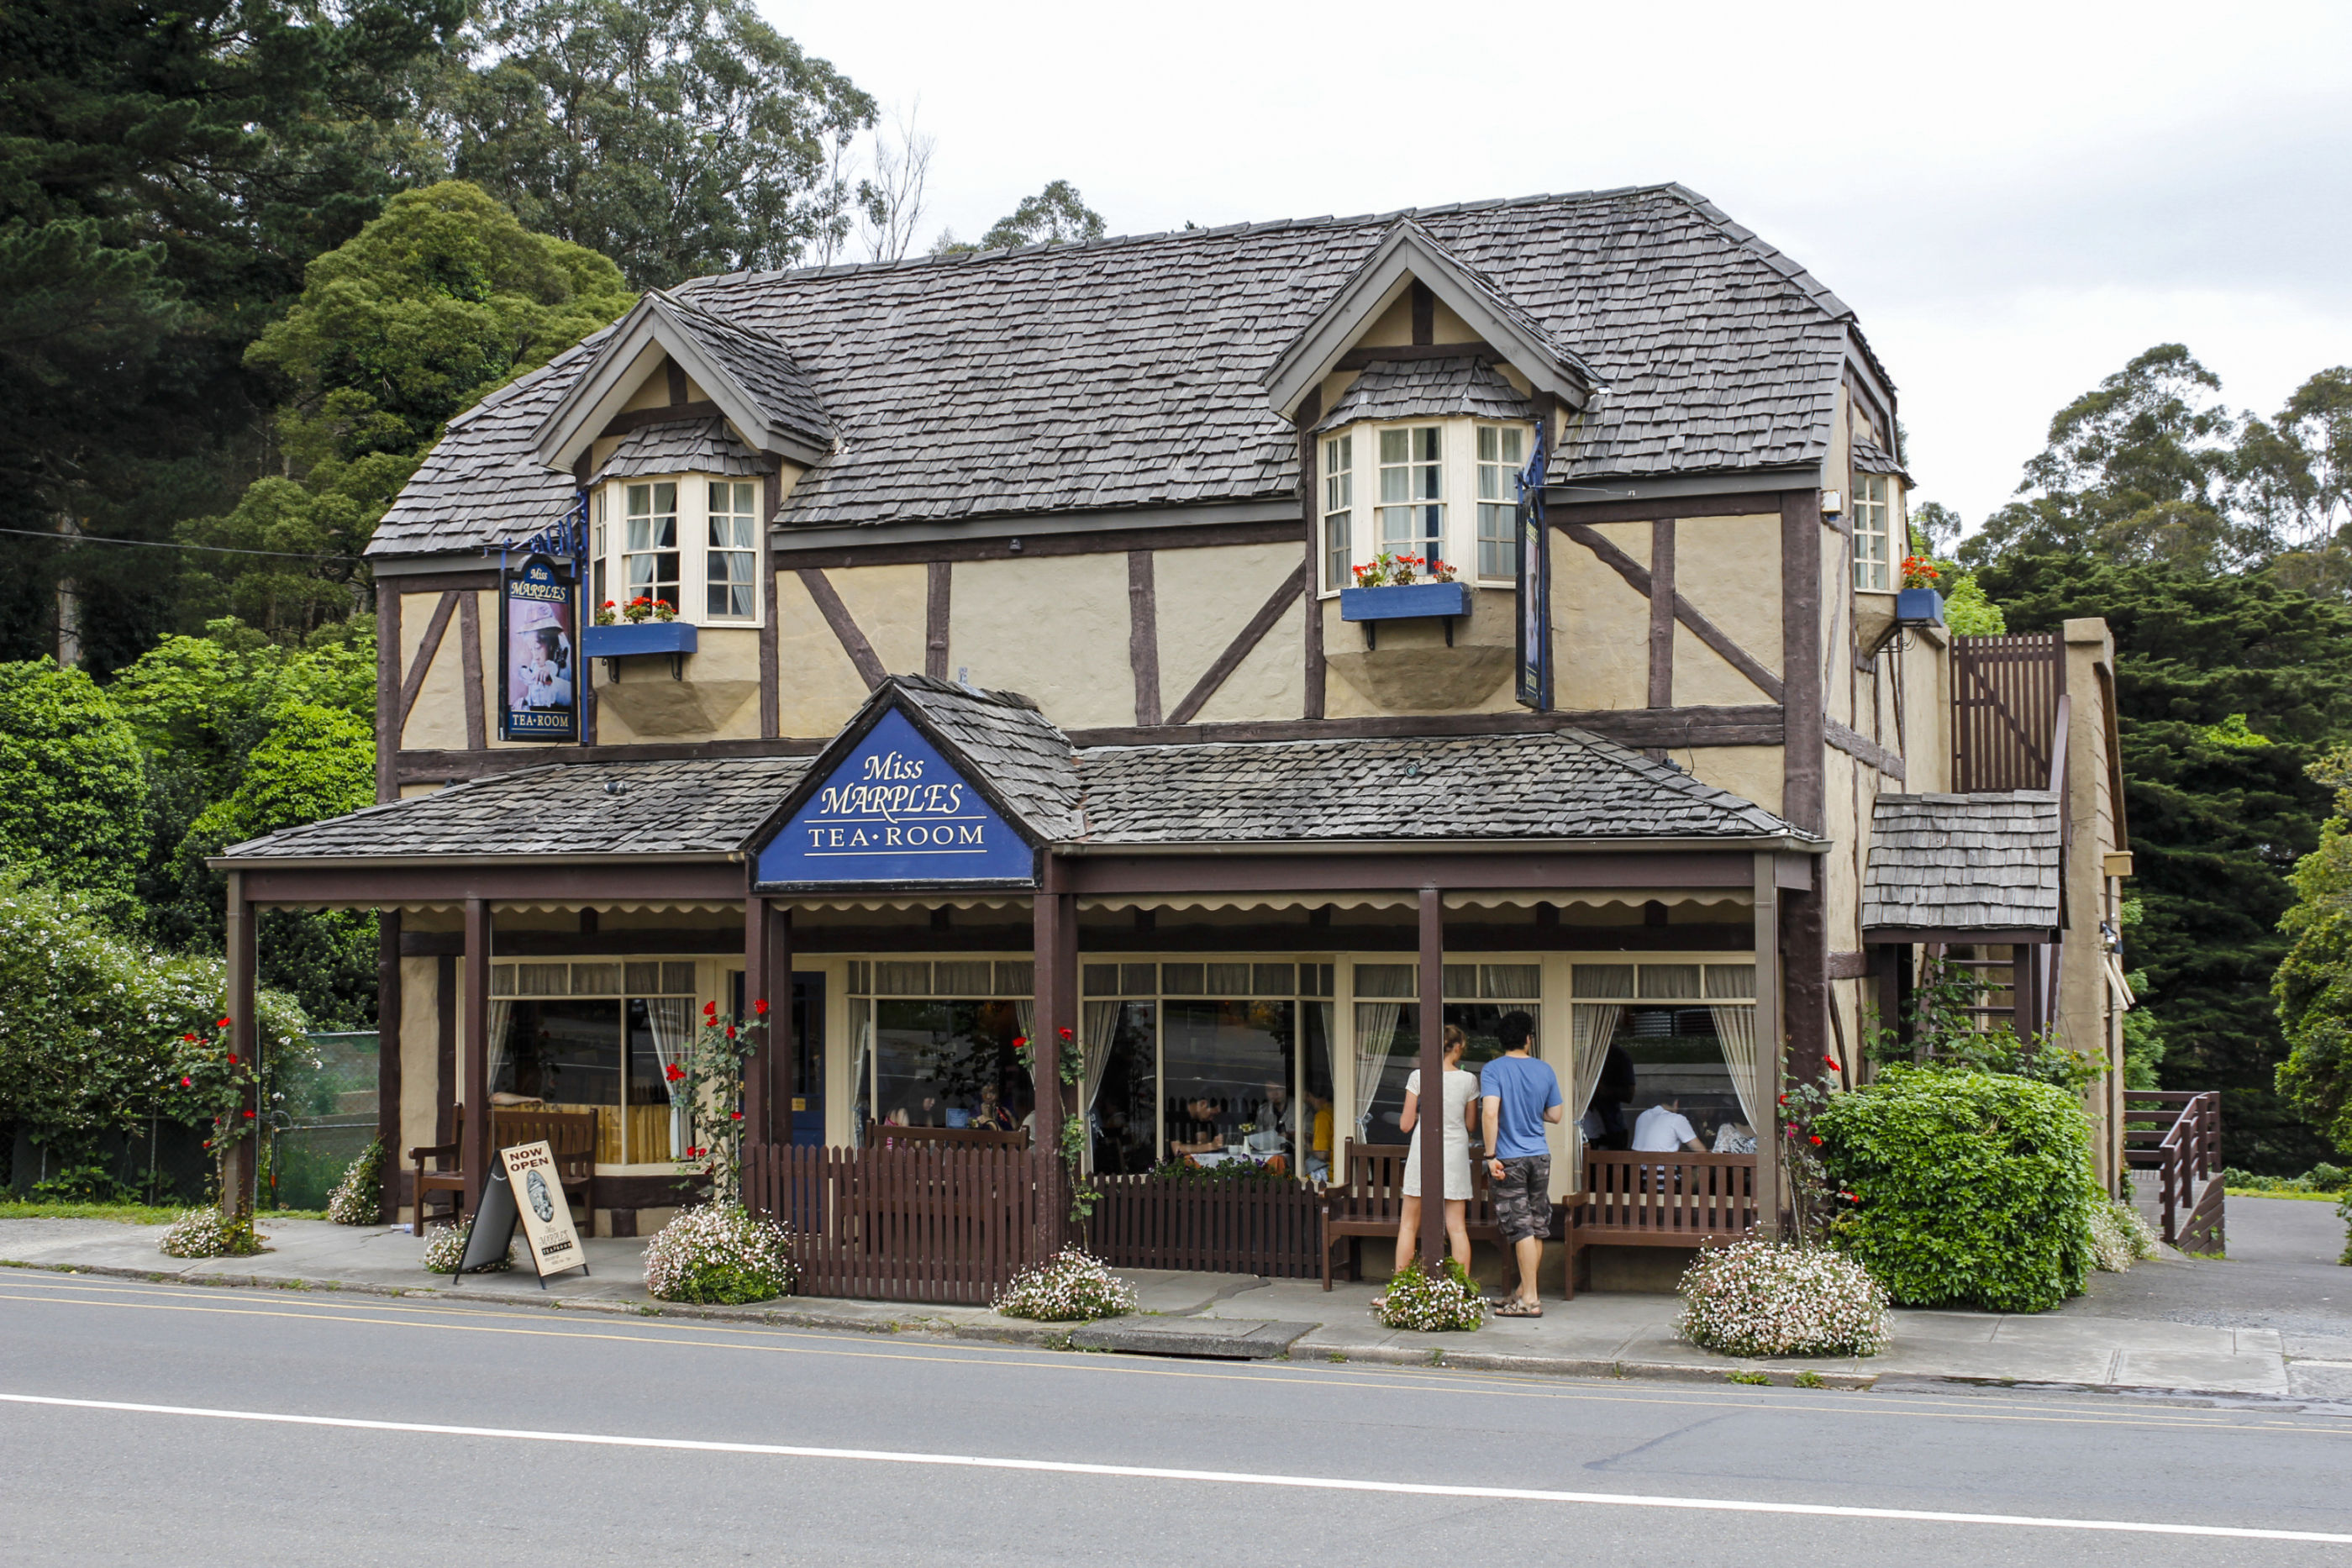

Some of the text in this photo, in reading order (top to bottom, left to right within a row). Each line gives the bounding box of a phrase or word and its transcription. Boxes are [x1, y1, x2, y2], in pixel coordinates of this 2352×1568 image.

[530, 567, 548, 580] Miss
[511, 581, 566, 601] MARPLES
[863, 750, 924, 781] Miss
[819, 782, 963, 824] MARPLES
[509, 1147, 542, 1161] NOW
[510, 1157, 549, 1172] OPEN
